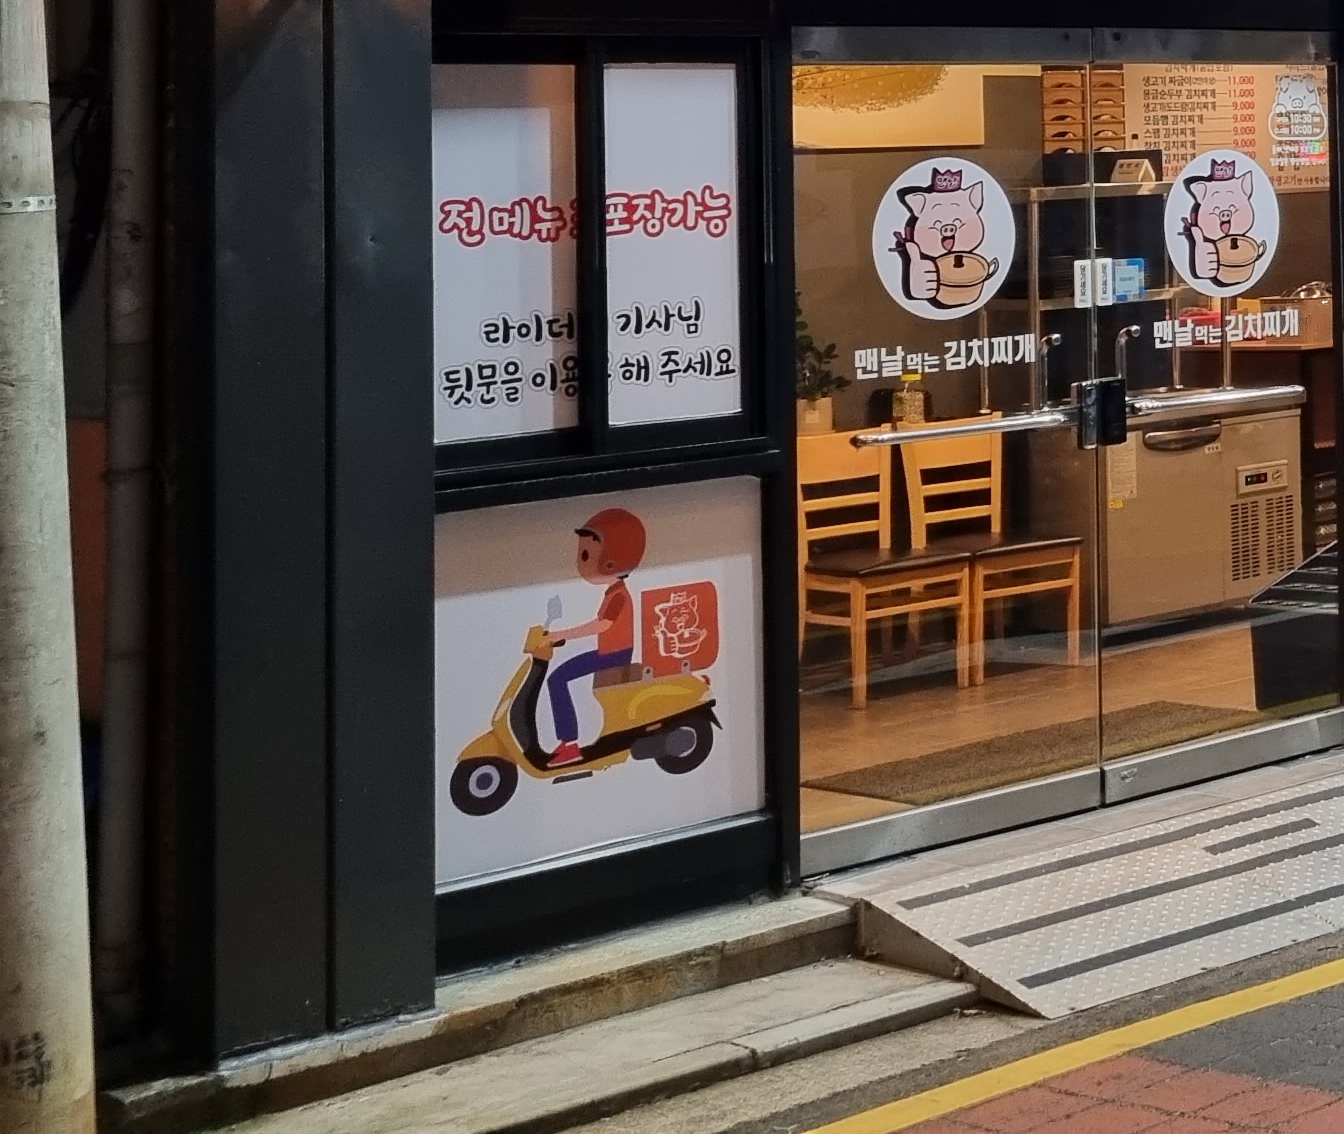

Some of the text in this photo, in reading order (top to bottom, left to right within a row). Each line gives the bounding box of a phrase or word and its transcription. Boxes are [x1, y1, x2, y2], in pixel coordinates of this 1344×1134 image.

[1185, 89, 1216, 100] 김치찌개
[1171, 114, 1204, 126] 김치찌개
[1290, 113, 1312, 124] 10:30
[1144, 128, 1160, 139] 스팸
[1162, 127, 1196, 139] 김치찌개
[1290, 124, 1313, 135] 10:00
[1163, 139, 1196, 152] 김치찌개
[438, 184, 732, 248] 전 메뉴 포장가능
[482, 300, 704, 345] 라이더 기사님
[1154, 307, 1299, 350] 맨날 먹는 김치찌개
[854, 333, 1037, 381] 맨날 먹는 김치찌개
[442, 360, 524, 407] 뒷문을
[660, 347, 738, 385] 주세요
